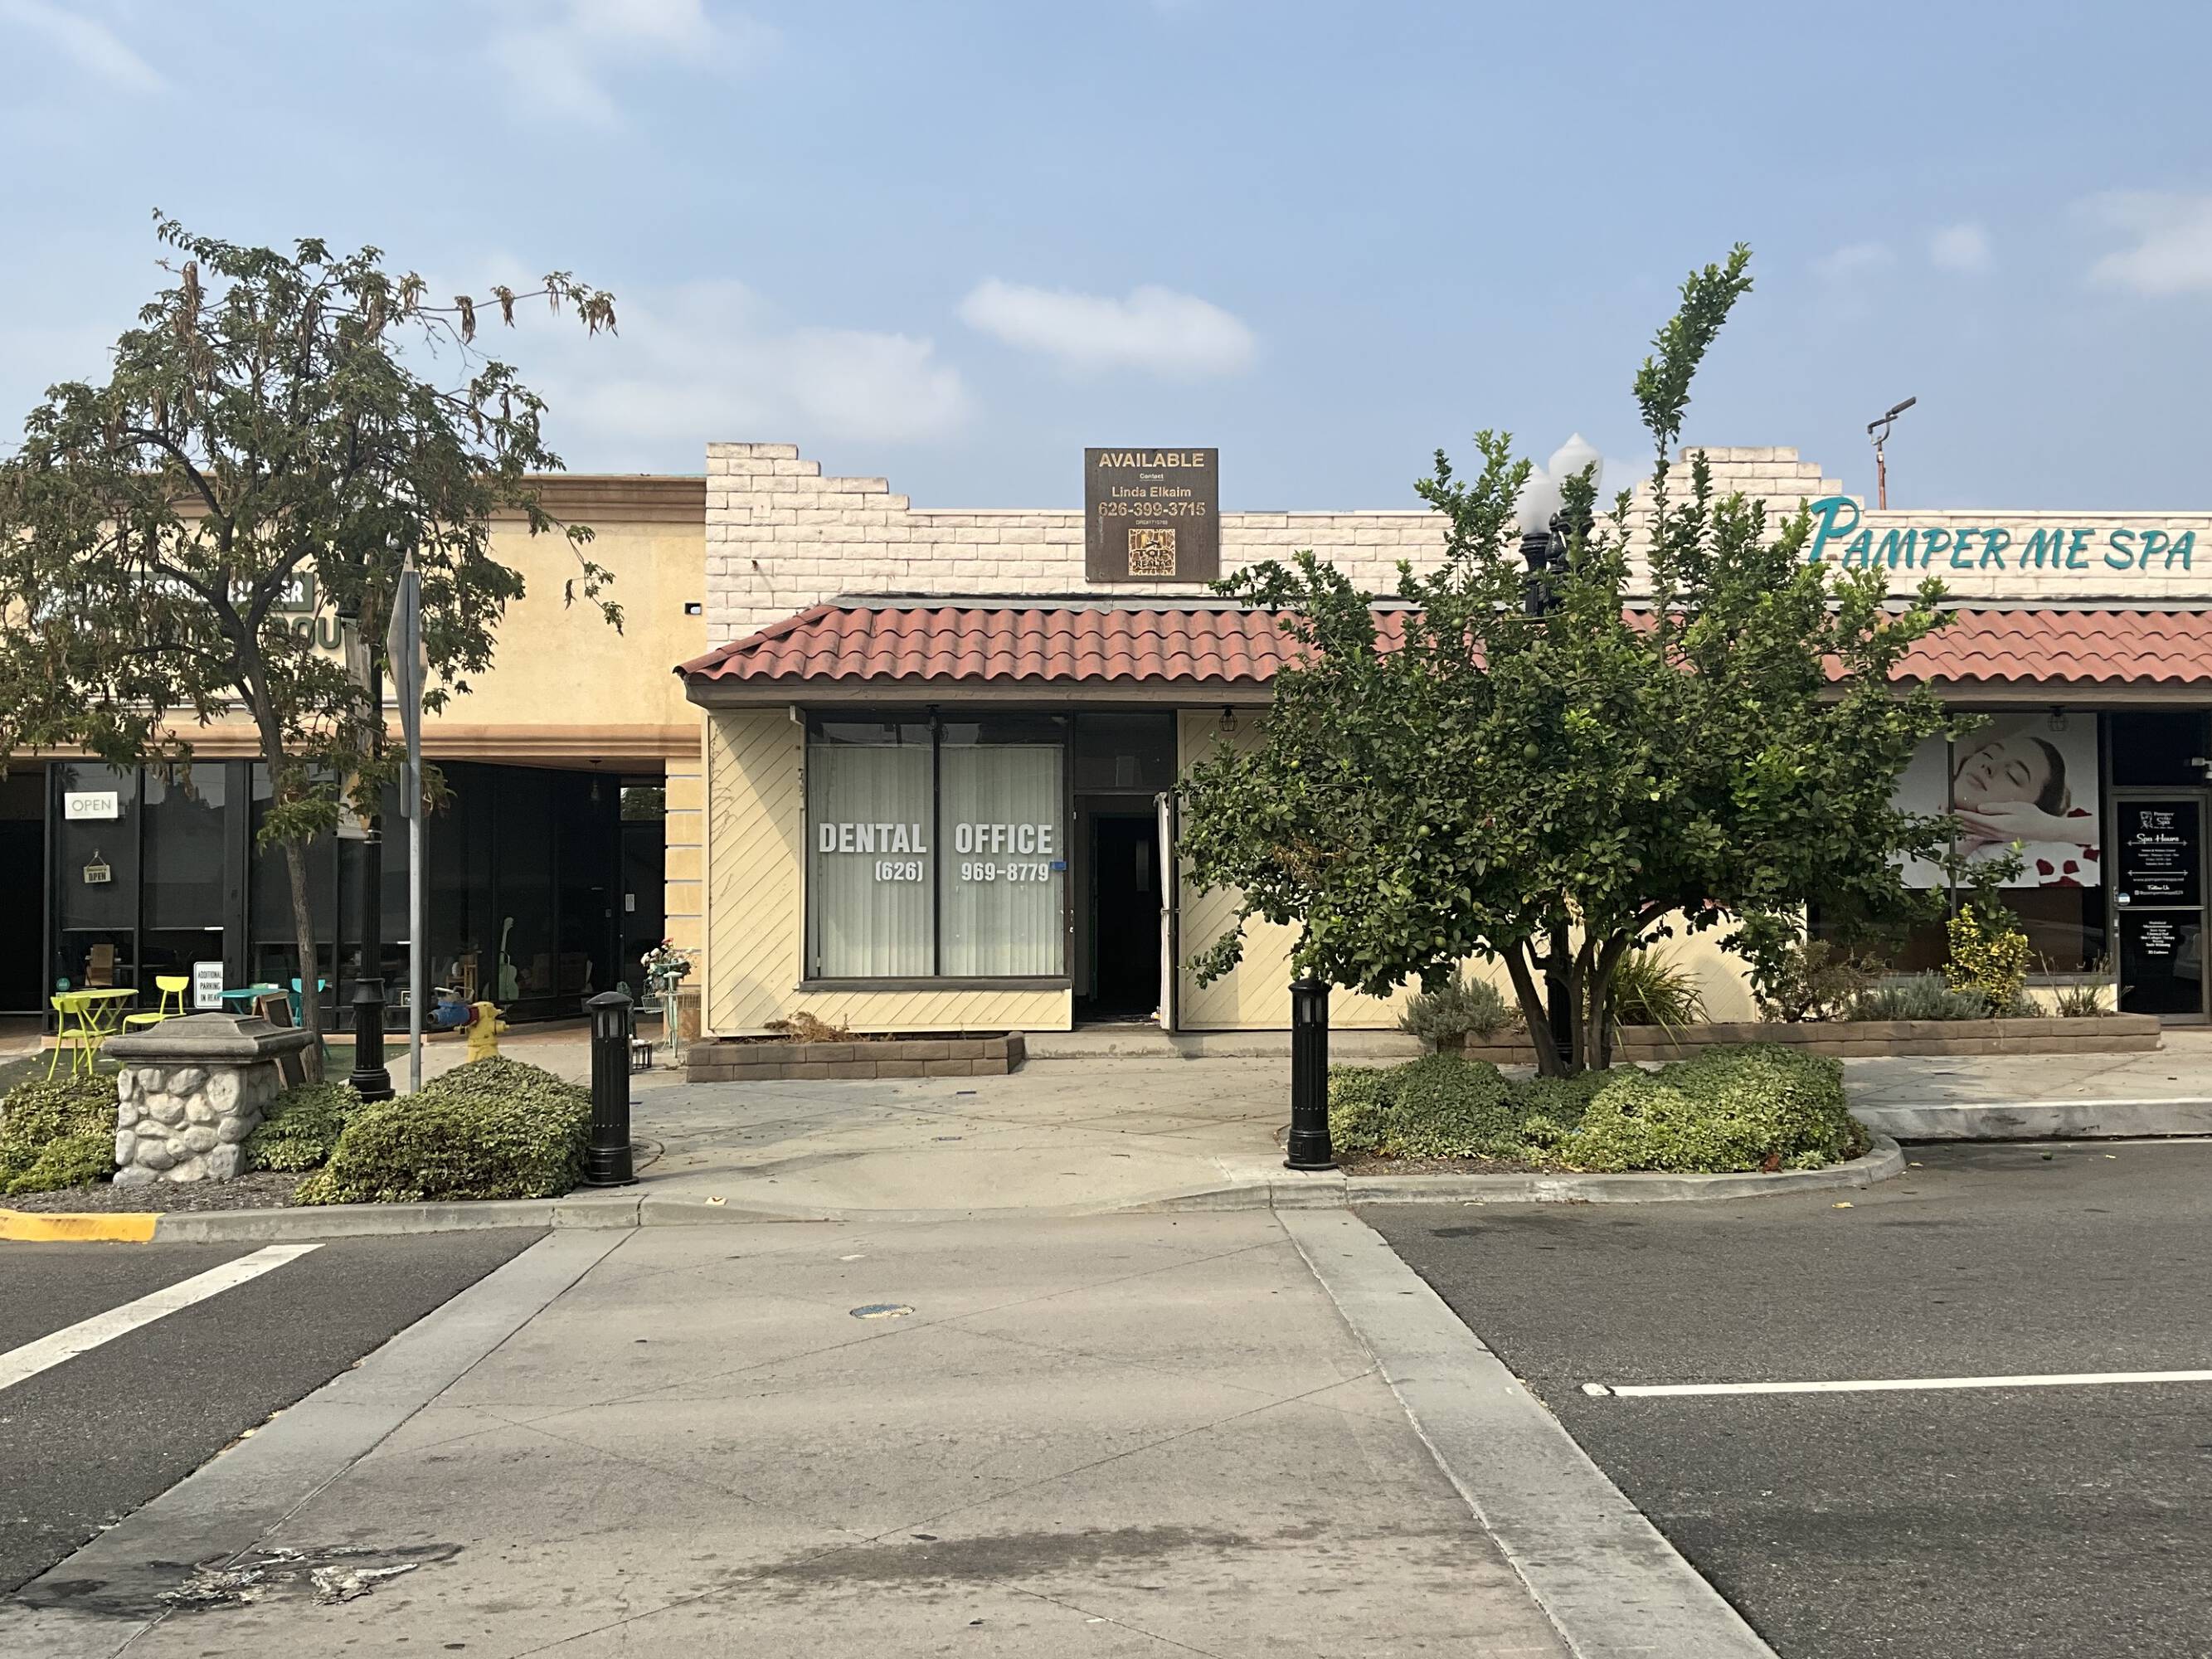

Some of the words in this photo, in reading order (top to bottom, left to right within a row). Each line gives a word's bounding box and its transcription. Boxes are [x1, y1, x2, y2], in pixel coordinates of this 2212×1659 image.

[1099, 453, 1204, 468] AVAILABLE
[1112, 486, 1146, 497] Linda
[1150, 486, 1191, 497] Elkaim
[1098, 502, 1206, 516] 626-399-3715
[1809, 496, 2012, 569] PAMPER
[2020, 528, 2096, 569] ME
[2103, 528, 2195, 570] SPA
[72, 799, 111, 812] OPEN
[819, 823, 927, 854] DENTAL
[955, 823, 1053, 854] OFFICE
[2137, 833, 2153, 844] Spa
[2155, 833, 2180, 842] Hours
[88, 872, 106, 881] OPEN
[875, 860, 923, 882] (626)
[961, 861, 1049, 882] 969-8779
[197, 971, 222, 979] ADDITIONAL
[200, 994, 207, 1002] IN
